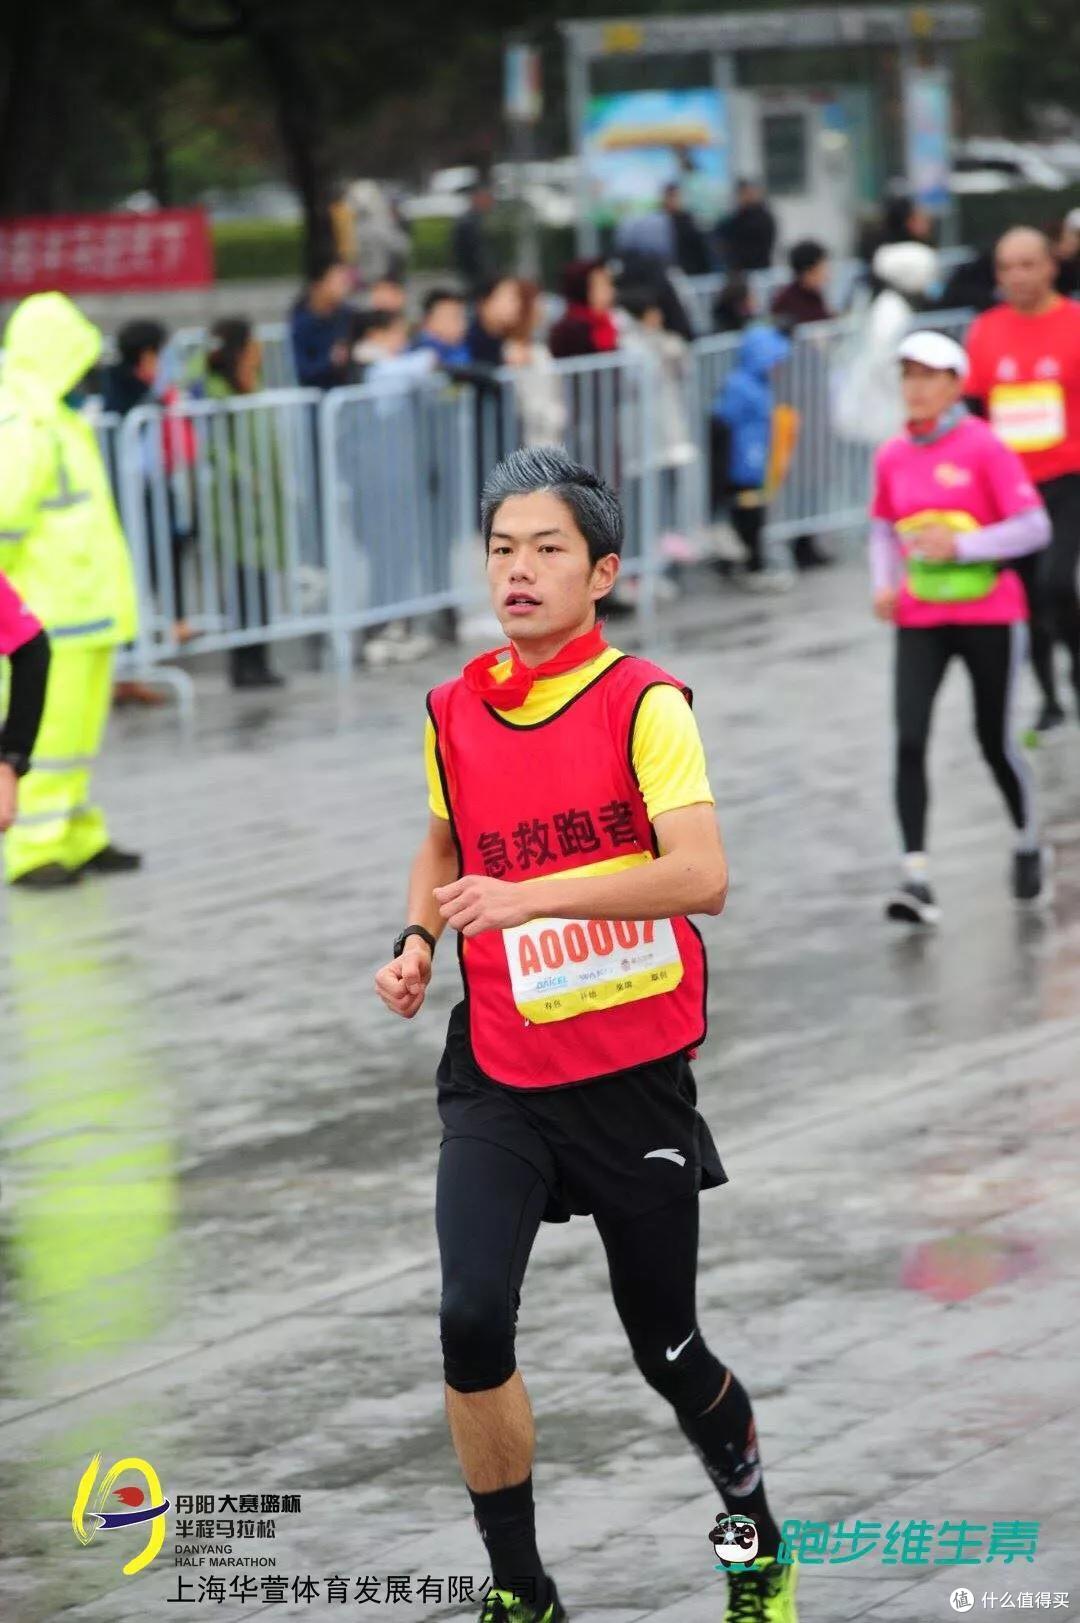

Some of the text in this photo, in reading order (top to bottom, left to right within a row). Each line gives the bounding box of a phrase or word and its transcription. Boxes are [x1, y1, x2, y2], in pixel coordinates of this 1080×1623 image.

[477, 800, 638, 877] 急救跑者
[518, 919, 656, 976] A00007
